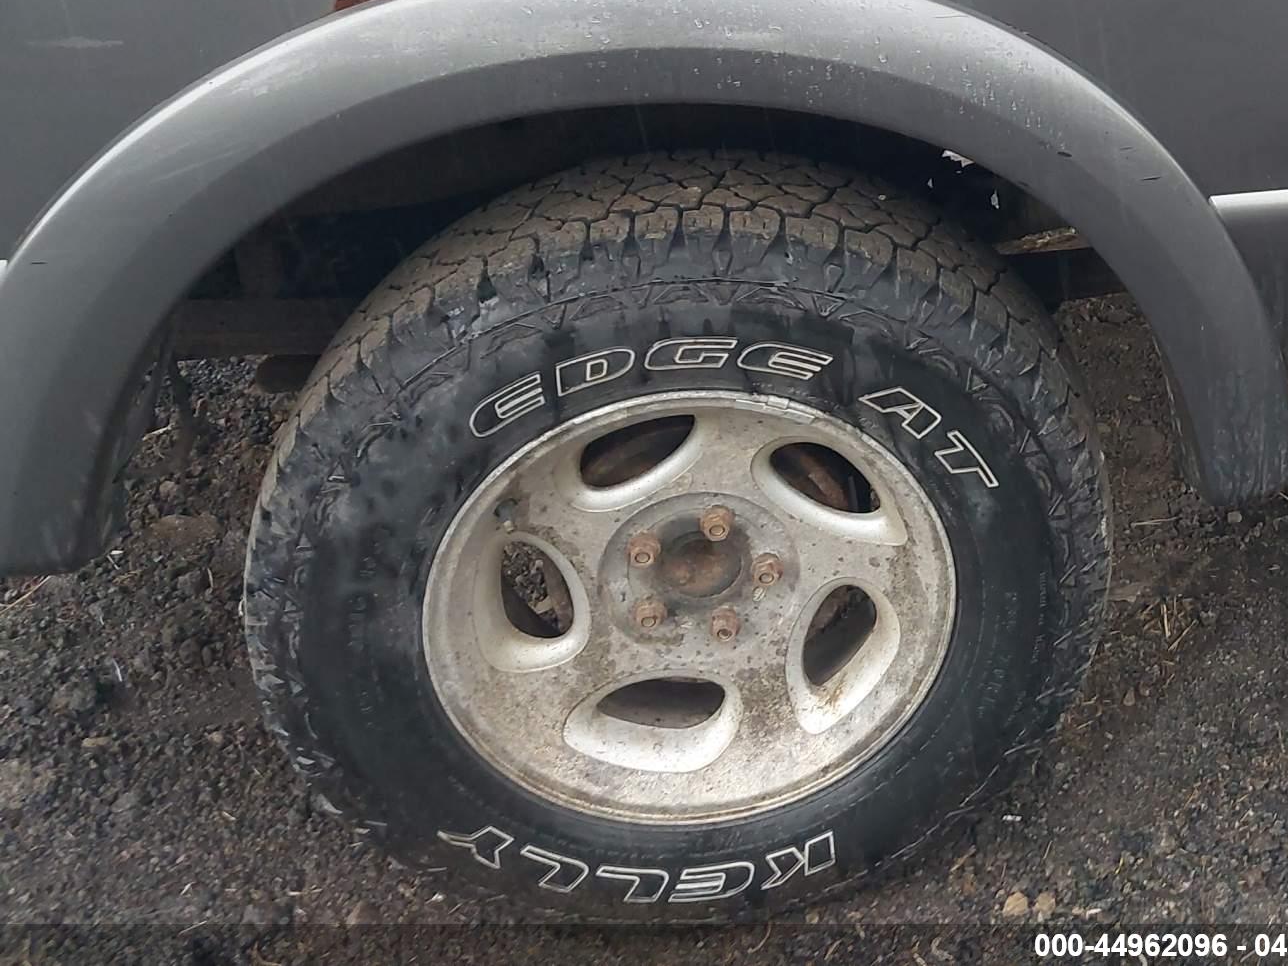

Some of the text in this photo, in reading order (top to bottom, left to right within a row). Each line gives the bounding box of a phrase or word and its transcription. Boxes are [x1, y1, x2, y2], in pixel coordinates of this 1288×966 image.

[469, 336, 999, 489] EDGE AT
[437, 825, 837, 904] KELLY
